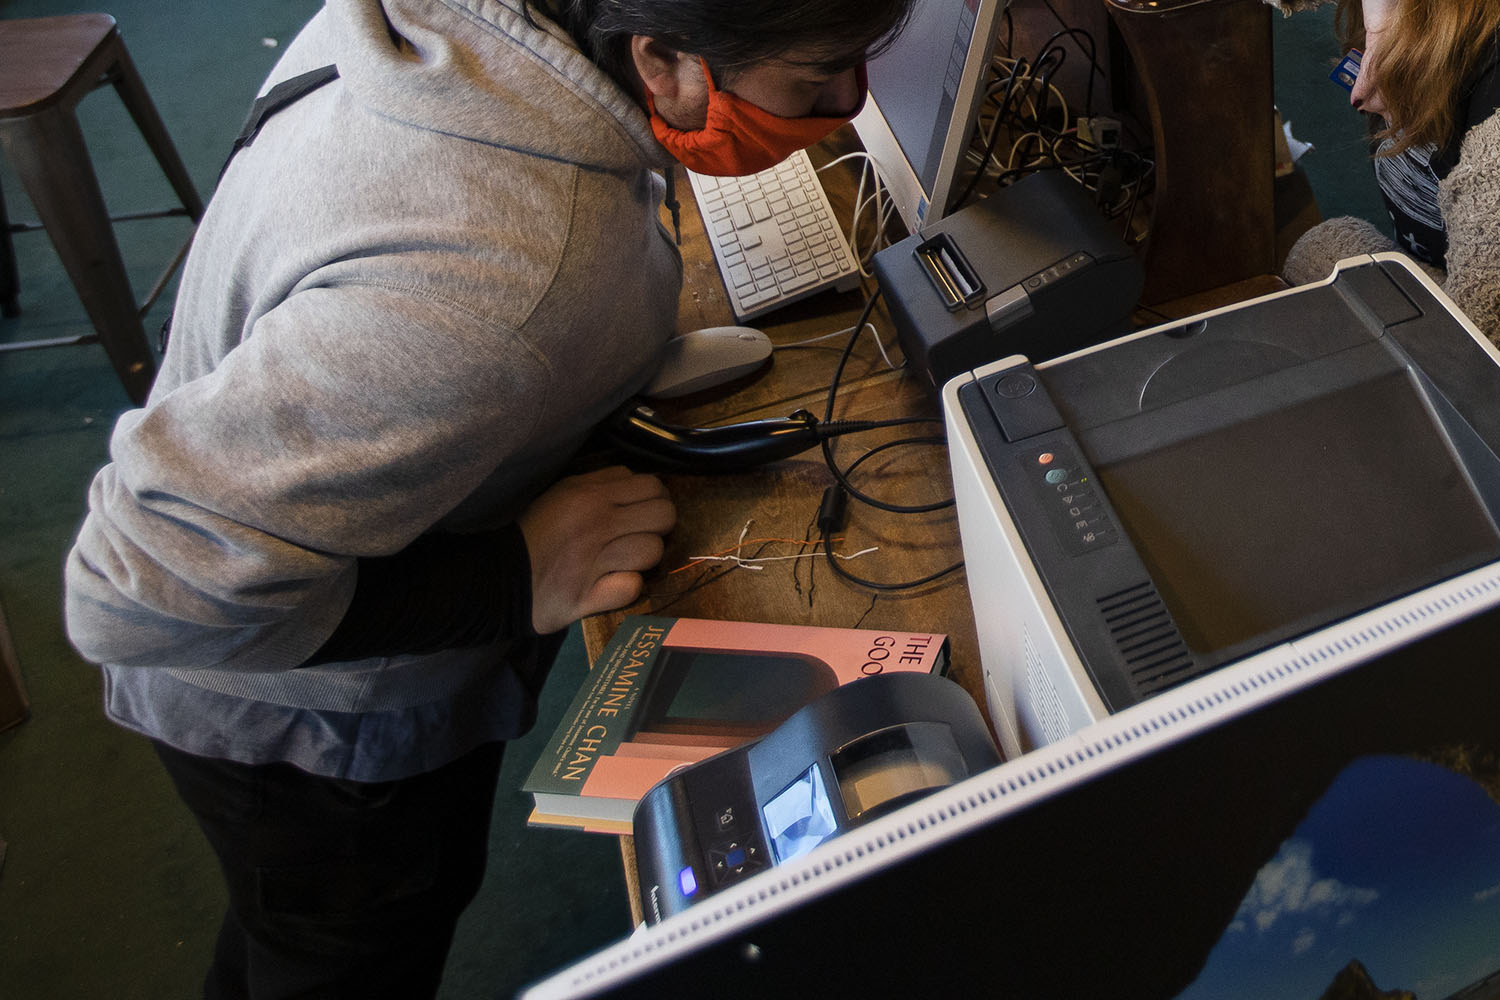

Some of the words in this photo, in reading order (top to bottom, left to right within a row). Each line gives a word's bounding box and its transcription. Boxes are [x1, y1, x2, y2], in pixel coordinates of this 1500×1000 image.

[594, 624, 667, 718] JESSAMINE
[857, 636, 896, 680] GOO
[899, 636, 932, 664] THE
[559, 724, 610, 782] CHAN
[650, 885, 662, 926] Interm
